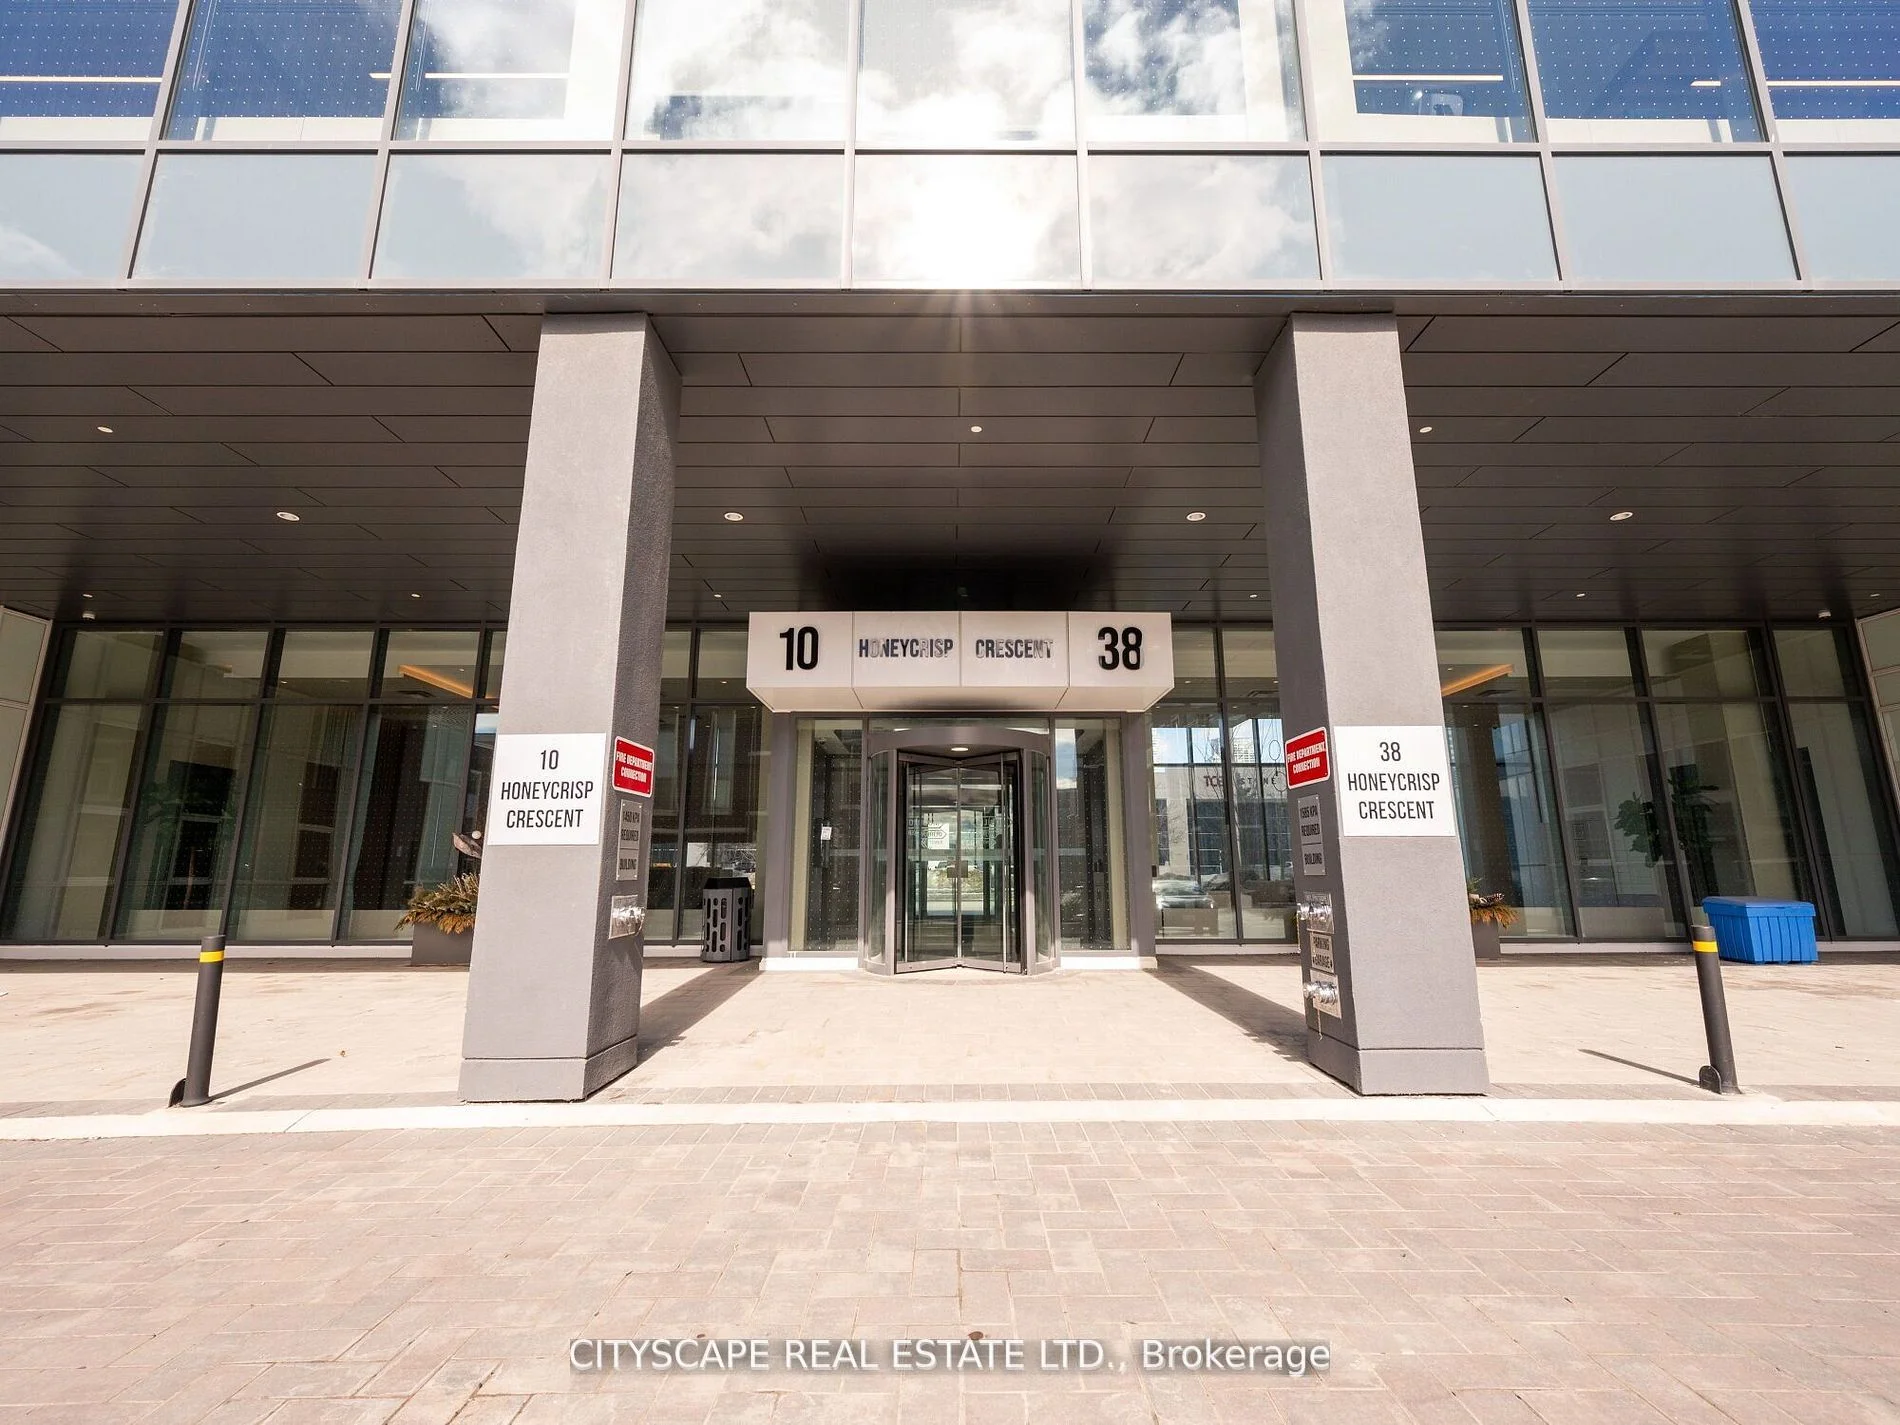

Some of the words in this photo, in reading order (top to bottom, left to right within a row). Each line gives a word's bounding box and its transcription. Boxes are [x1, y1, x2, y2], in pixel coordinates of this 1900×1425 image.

[779, 626, 819, 671] 10
[858, 638, 954, 658] HONEYCRISP
[975, 638, 1053, 658] CRESCENT
[1097, 626, 1143, 671] 38
[540, 749, 559, 770] 10
[616, 751, 627, 763] FIRE
[627, 754, 653, 772] DEPARTMENT
[1287, 751, 1296, 763] FIRE
[1296, 741, 1326, 760] DEPARTMENT
[1380, 741, 1402, 762] 38
[620, 766, 647, 783] CONNECTION
[1292, 757, 1321, 774] CONNECTION
[501, 780, 594, 800] HONEYCRISP
[1347, 772, 1440, 792] HONEYCRISP
[506, 809, 584, 829] CRESCENT
[1358, 800, 1435, 820] CRESCENT
